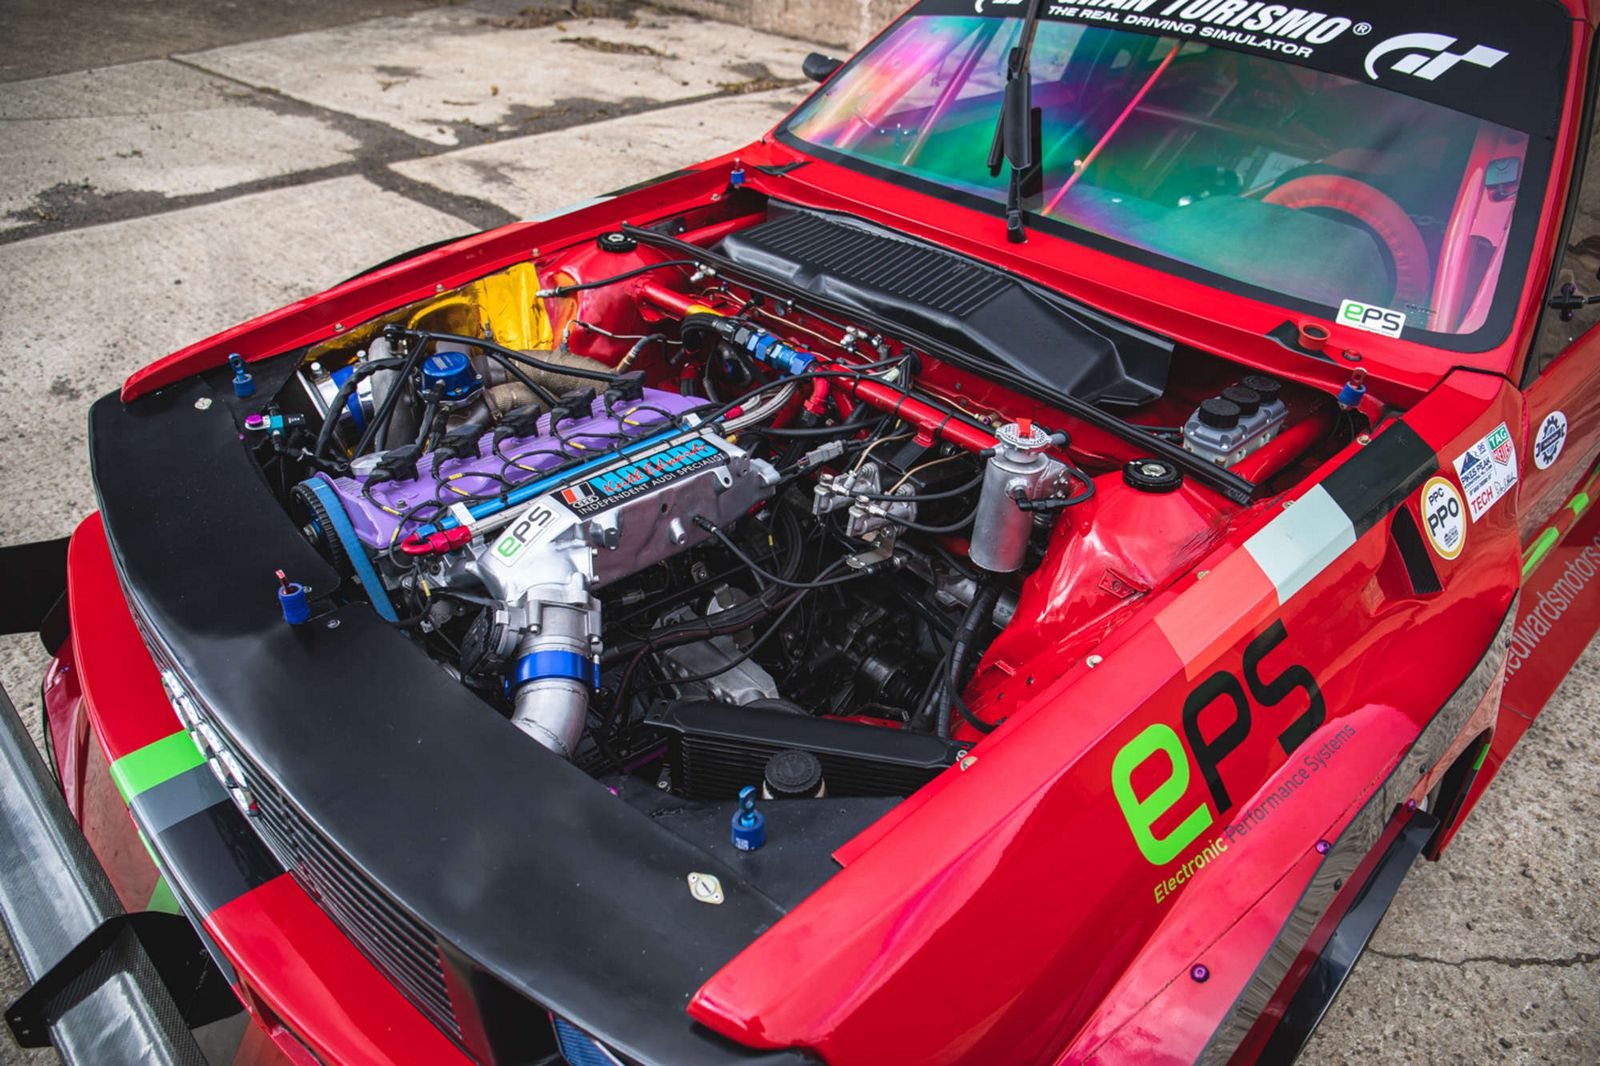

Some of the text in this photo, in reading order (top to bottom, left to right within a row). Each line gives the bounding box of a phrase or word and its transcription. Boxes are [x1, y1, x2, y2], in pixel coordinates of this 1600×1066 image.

[1048, 5, 1079, 17] THE
[1079, 9, 1120, 22] REAL
[1123, 14, 1197, 34] DRIVING
[1199, 27, 1314, 58] SIMULATOR
[1489, 428, 1508, 448] TAG
[578, 453, 725, 515] INDEPENDENT AUDI SPECIALIST
[1428, 488, 1444, 506] PPC
[1471, 486, 1493, 514] TECH
[1427, 497, 1459, 537] PPO
[1153, 724, 1356, 904] Electronic Performance Systems
